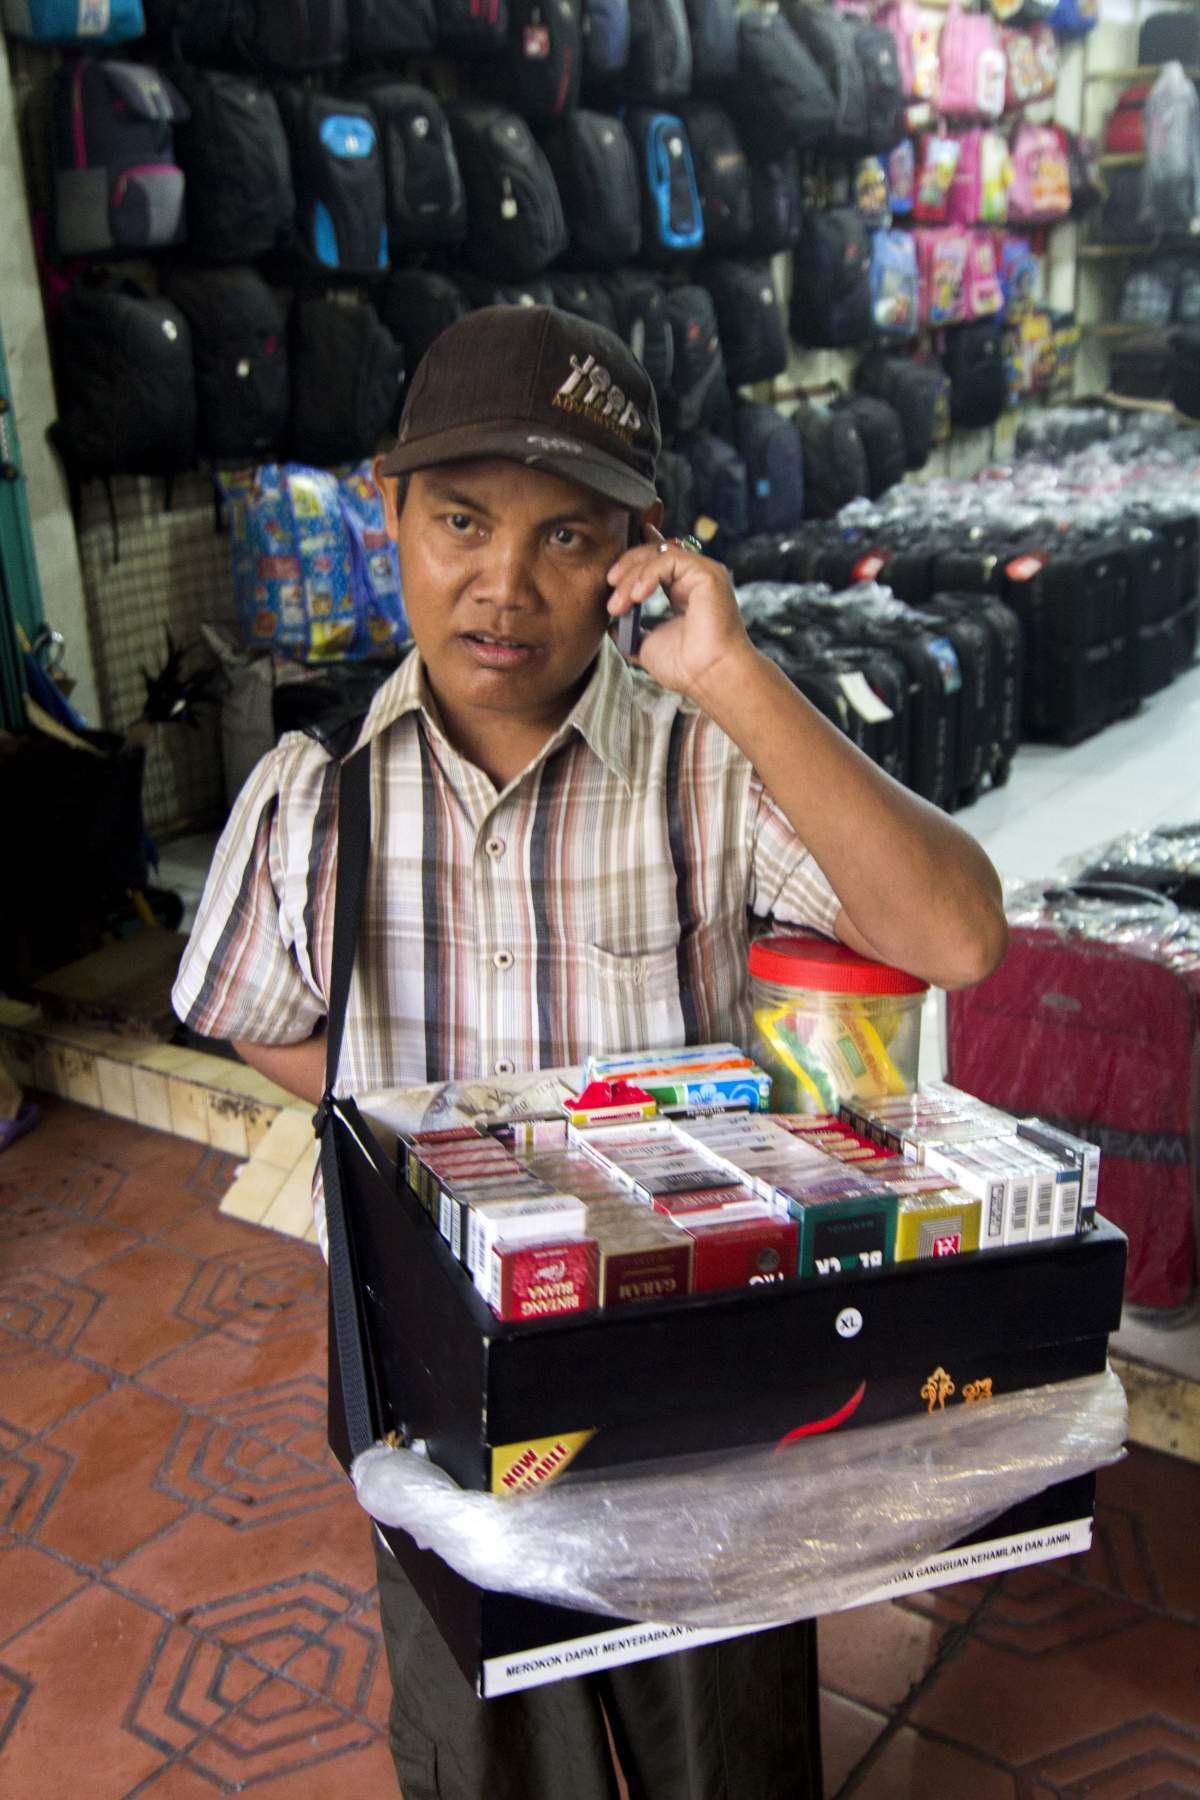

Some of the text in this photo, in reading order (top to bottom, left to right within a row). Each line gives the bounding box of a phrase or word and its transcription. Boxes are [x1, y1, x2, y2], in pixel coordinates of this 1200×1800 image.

[521, 1294, 579, 1316] BINTANG
[619, 1278, 677, 1299] GARAM
[501, 1448, 539, 1488] NOW
[916, 1557, 969, 1578] GANGGUAN
[970, 1544, 1023, 1565] KEHAMILAN
[1024, 1539, 1045, 1554] DAN
[1045, 1532, 1072, 1549] JANIN
[506, 1655, 563, 1678] MEROKOK
[565, 1645, 600, 1664] DAPAT
[602, 1626, 684, 1655] MENYEBABKAN
